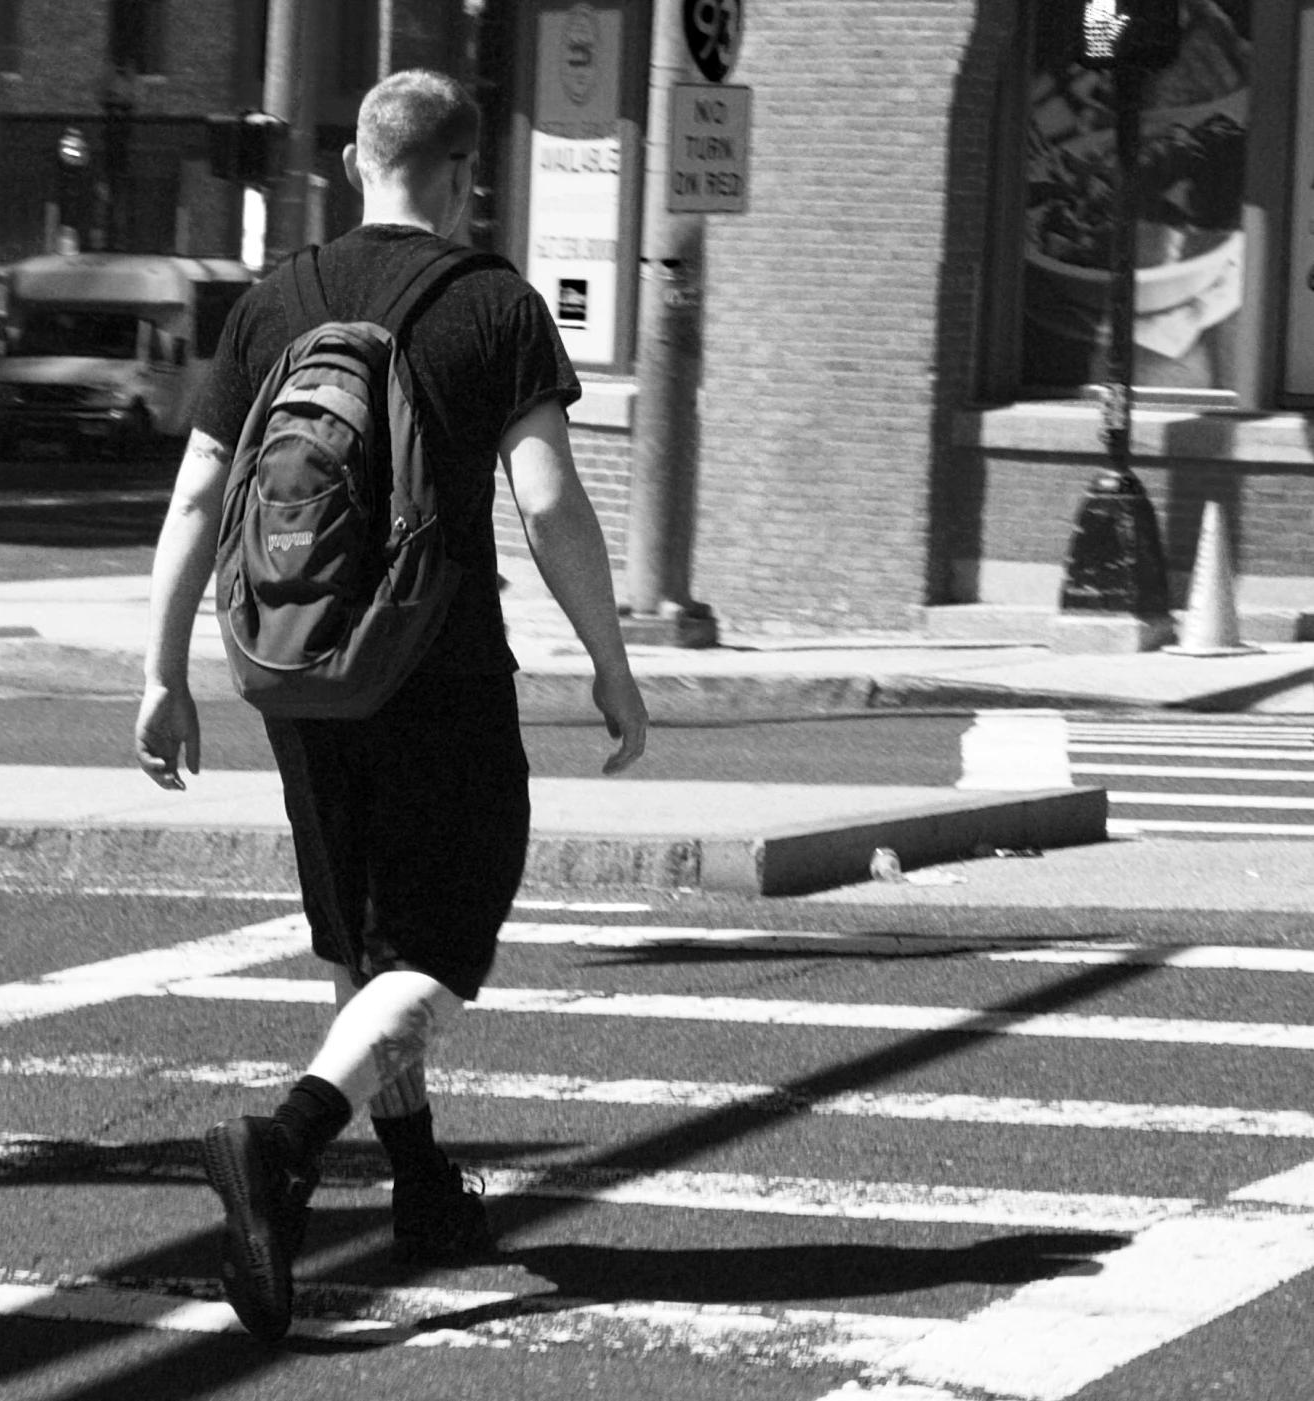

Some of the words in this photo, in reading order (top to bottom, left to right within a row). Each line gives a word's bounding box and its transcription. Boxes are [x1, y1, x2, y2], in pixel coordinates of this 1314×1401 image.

[693, 99, 727, 125] NO
[684, 135, 735, 161] TURN
[672, 170, 701, 196] ON
[704, 171, 743, 197] RED
